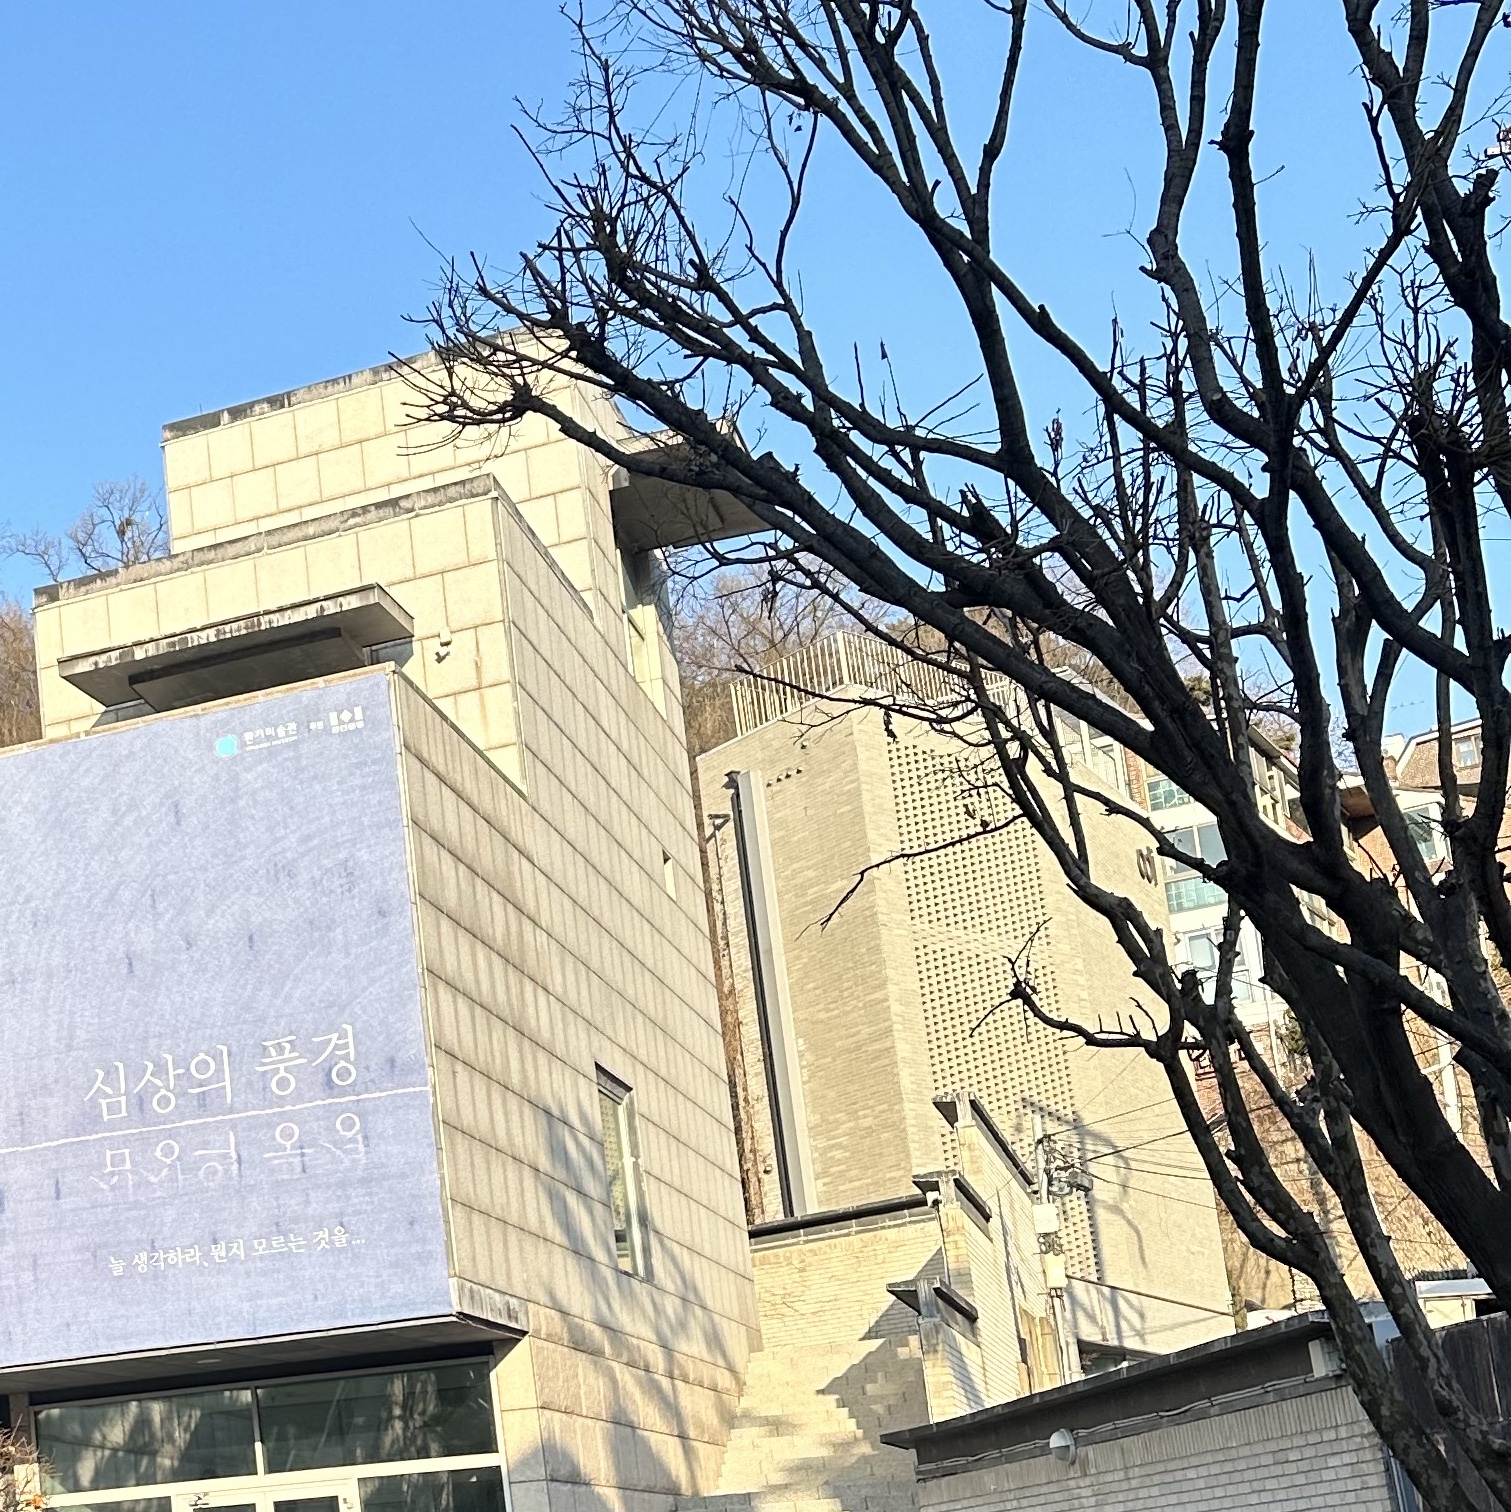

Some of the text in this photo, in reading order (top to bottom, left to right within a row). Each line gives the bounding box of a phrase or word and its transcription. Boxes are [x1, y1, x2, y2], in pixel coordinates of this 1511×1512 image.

[84, 1023, 357, 1122] 심상의 풍경
[108, 1256, 126, 1277] 늘
[209, 1238, 245, 1263] 뭔지
[251, 1233, 307, 1257] 모르는
